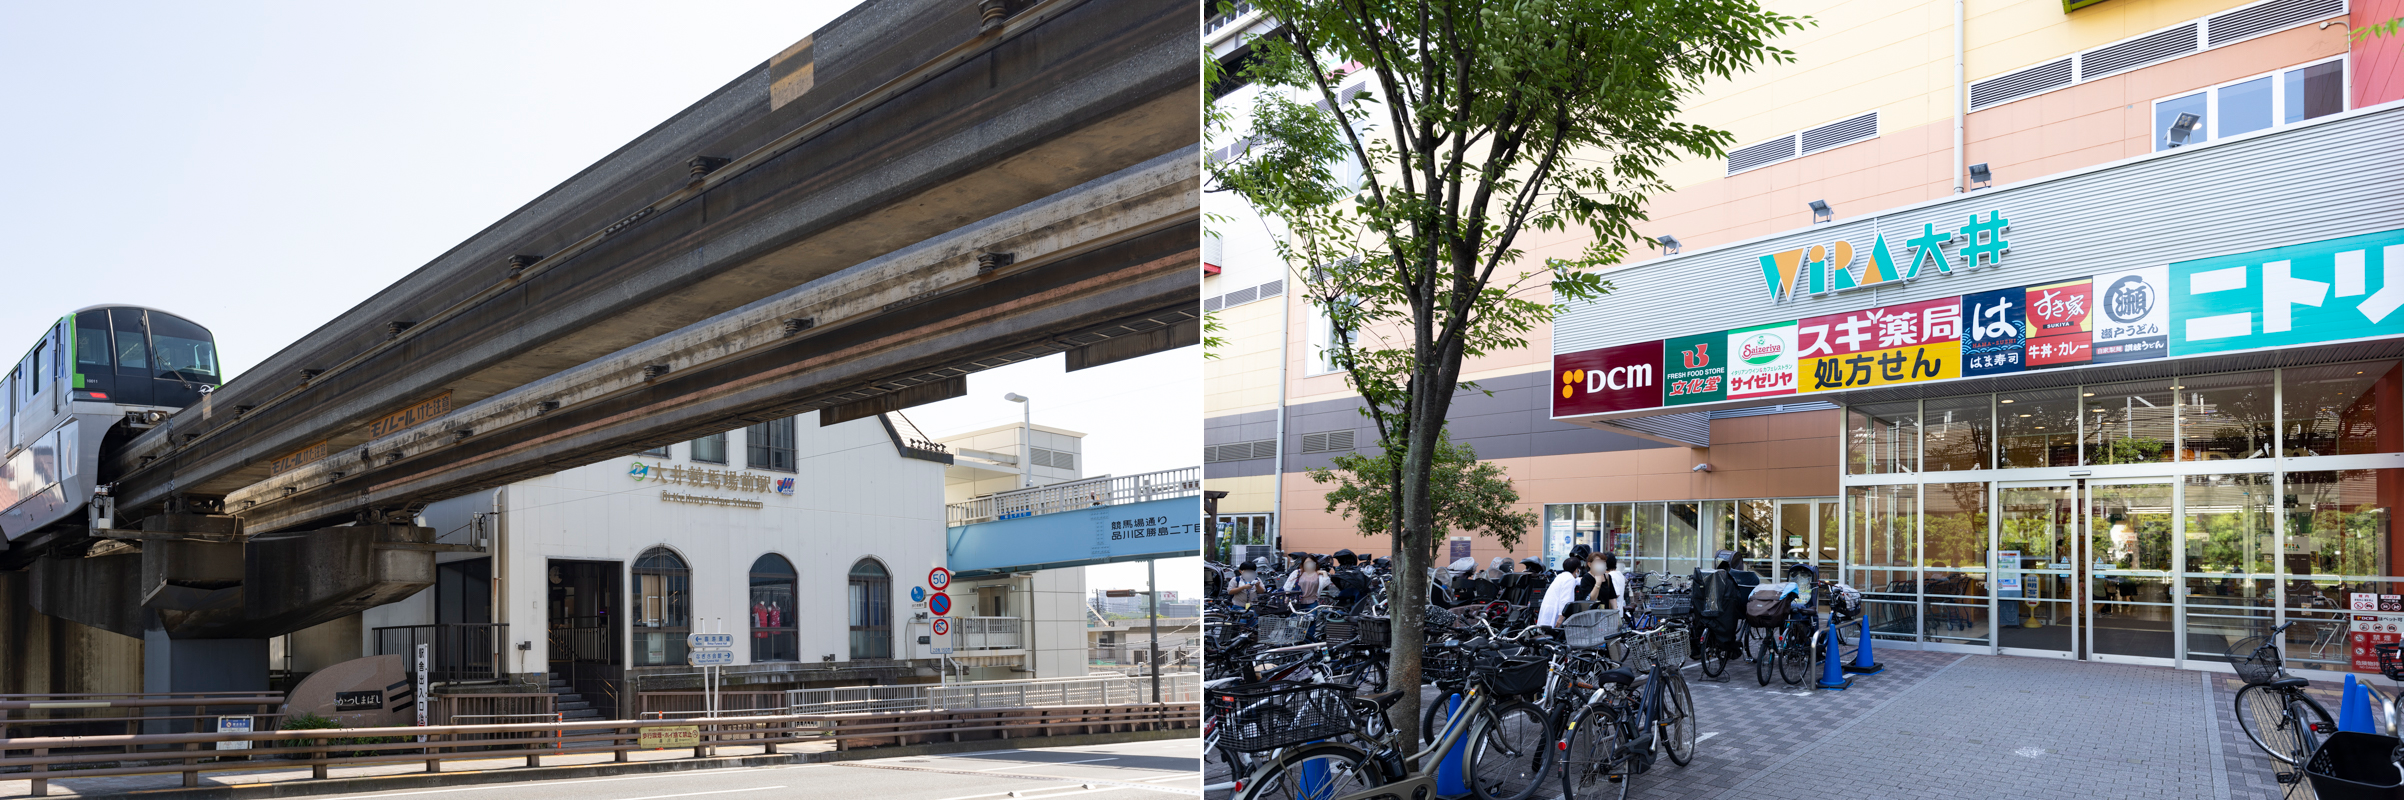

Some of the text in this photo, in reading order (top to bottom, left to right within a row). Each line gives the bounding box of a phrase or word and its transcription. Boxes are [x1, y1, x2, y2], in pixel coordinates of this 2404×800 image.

[1906, 210, 2009, 280] 大井
[2033, 290, 2085, 321] すき家
[1972, 296, 2017, 341] は
[1798, 303, 1961, 358] スギ薬局
[2101, 323, 2158, 339] 瀬戸うどん
[1742, 344, 1781, 359] Saizeriya
[1970, 352, 2019, 369] はま寿司
[1587, 363, 1652, 394] DCM
[1705, 367, 1725, 375] STORE
[1814, 347, 1941, 390] 処方せん
[1669, 376, 1722, 396] 文化堂
[1731, 372, 1793, 391] サイゼリヤ
[370, 396, 450, 438] モノレールけた注意
[651, 462, 772, 494] 大井競馬場前駅
[1111, 516, 1167, 530] 競馬場通り
[932, 573, 946, 585] 50
[338, 695, 381, 706] かつしまばし
